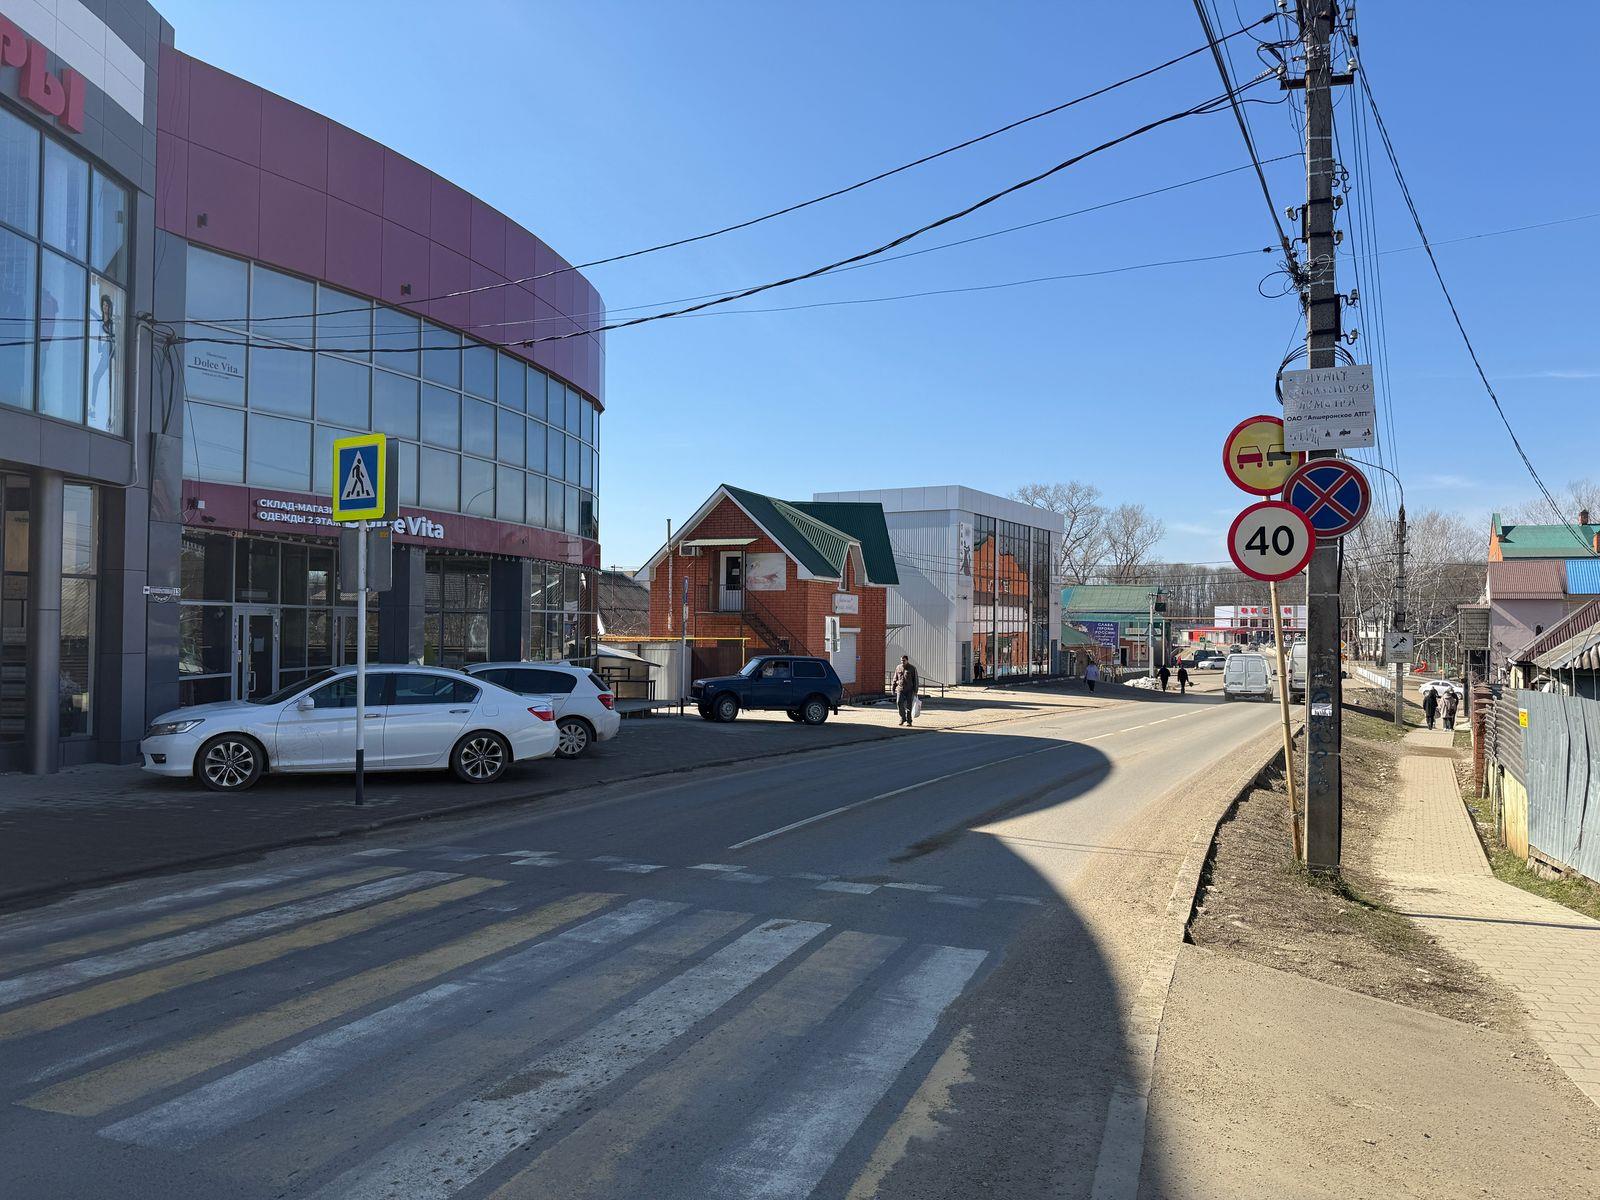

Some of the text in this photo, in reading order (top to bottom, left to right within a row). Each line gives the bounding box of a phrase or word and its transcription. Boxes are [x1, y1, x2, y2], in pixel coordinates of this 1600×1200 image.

[194, 356, 219, 370] Dolce
[221, 362, 239, 374] Vita
[259, 511, 306, 524] ОДЕЖДЫ
[307, 516, 314, 524] 2
[406, 516, 445, 539] Vita
[1245, 525, 1295, 556] 40
